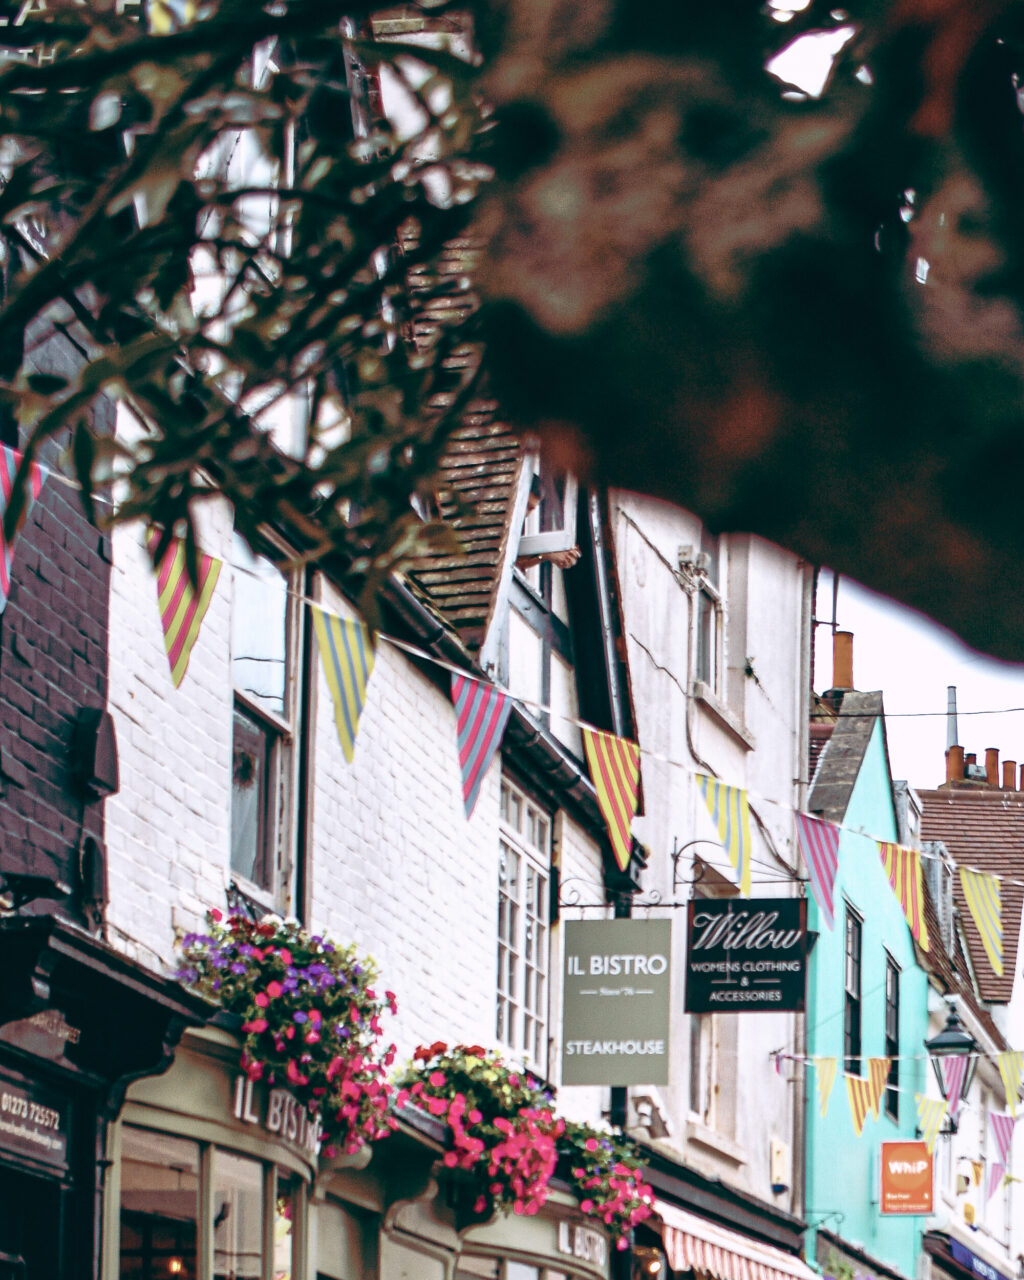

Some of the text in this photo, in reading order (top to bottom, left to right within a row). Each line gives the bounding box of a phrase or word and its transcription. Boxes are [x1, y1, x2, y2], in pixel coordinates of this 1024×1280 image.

[693, 911, 802, 950] Willow
[567, 954, 668, 975] IL BISTRO
[691, 960, 801, 973] WOMENS CLOTHING
[740, 976, 749, 987] &
[710, 990, 782, 1002] ACCESSORIES
[566, 1040, 665, 1055] STEAKHOUSE
[234, 1075, 259, 1124] IL
[1, 1091, 61, 1131] 01273 725572
